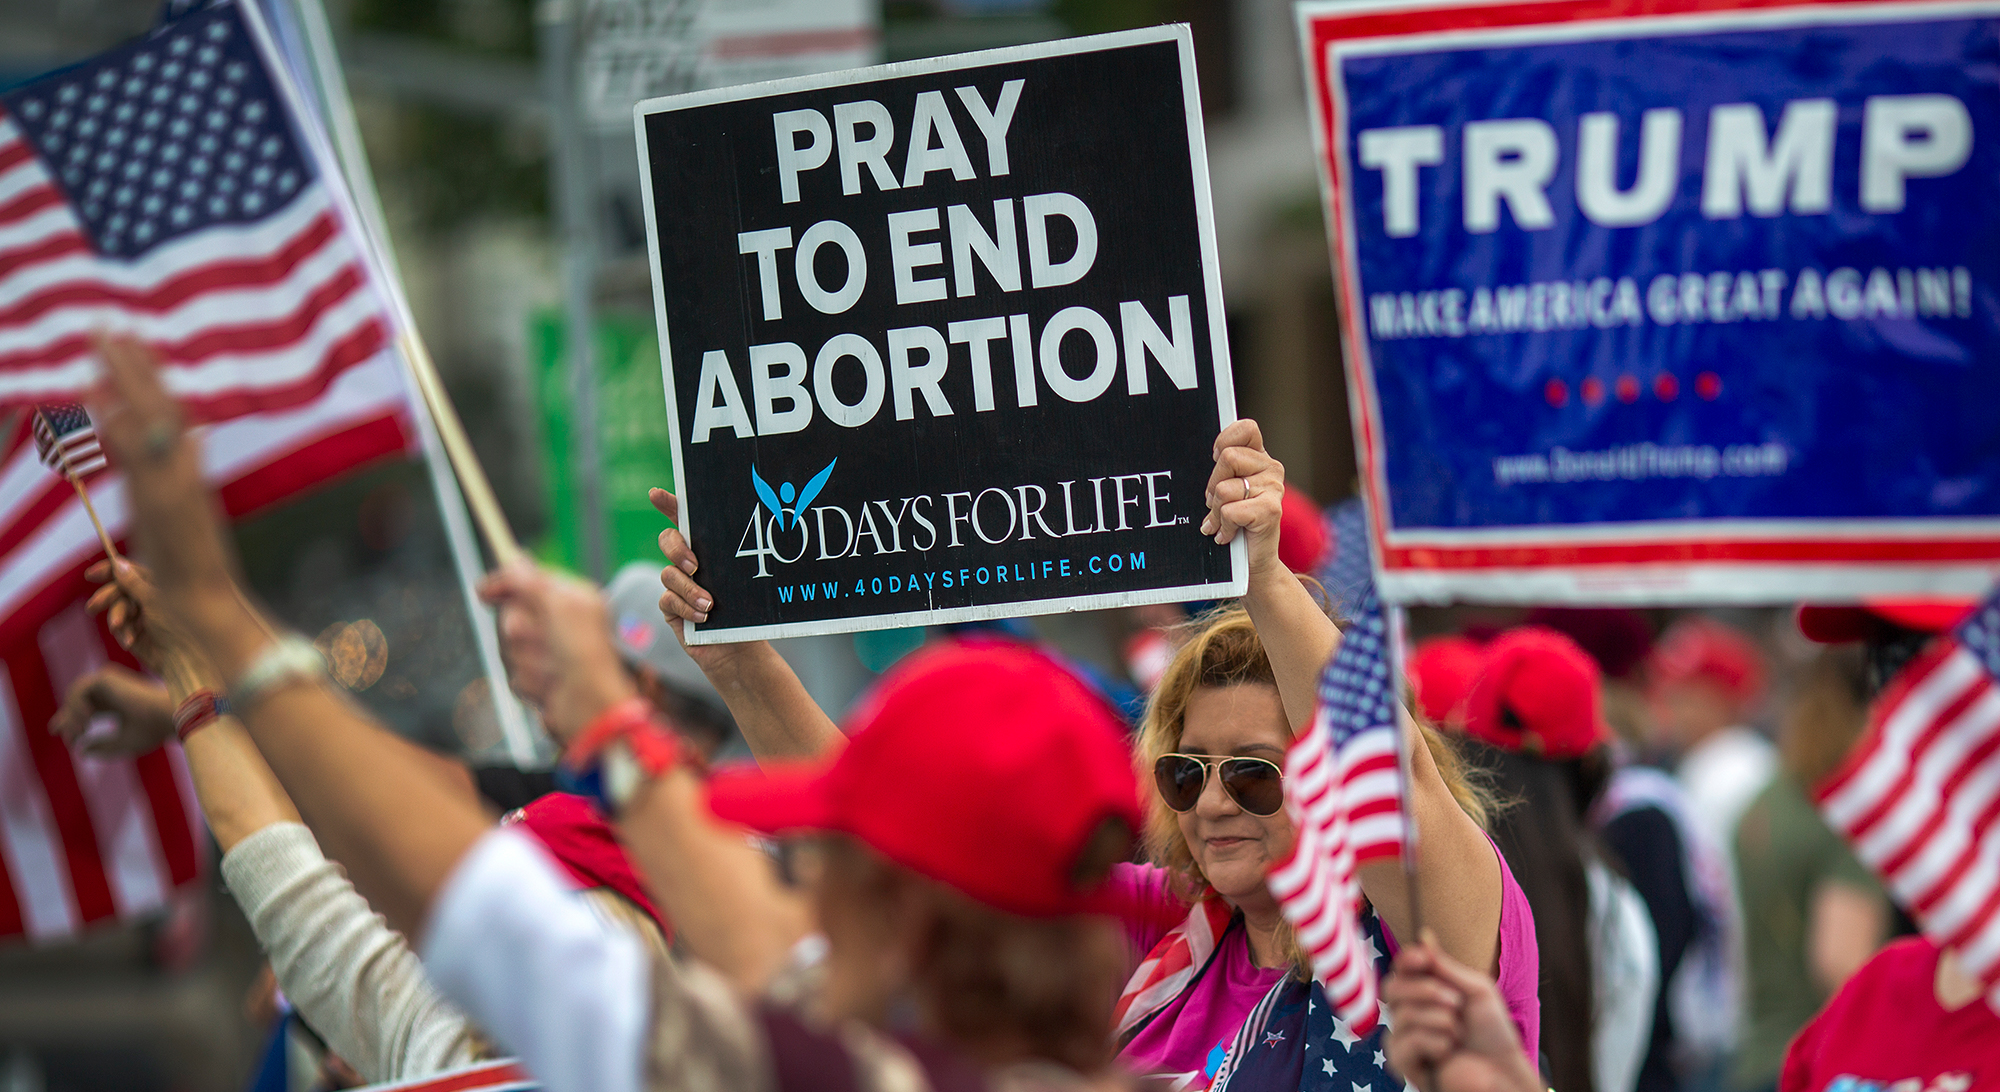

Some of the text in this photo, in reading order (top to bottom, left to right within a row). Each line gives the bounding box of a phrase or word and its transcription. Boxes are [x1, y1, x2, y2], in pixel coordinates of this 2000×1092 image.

[773, 79, 1026, 204] PRAY
[1358, 93, 1974, 238] TRUMP
[738, 192, 1098, 321] TO END
[1370, 266, 1972, 340] MAKE AMERICA GREAT AGAIN!
[691, 295, 1199, 444] ABORTION
[735, 502, 809, 579] 40
[811, 494, 937, 561] DAYS
[941, 485, 1062, 548] FOR
[1057, 470, 1177, 538] LIFE
[778, 551, 1147, 604] WWW.40DAYSFORLIFE.COM
